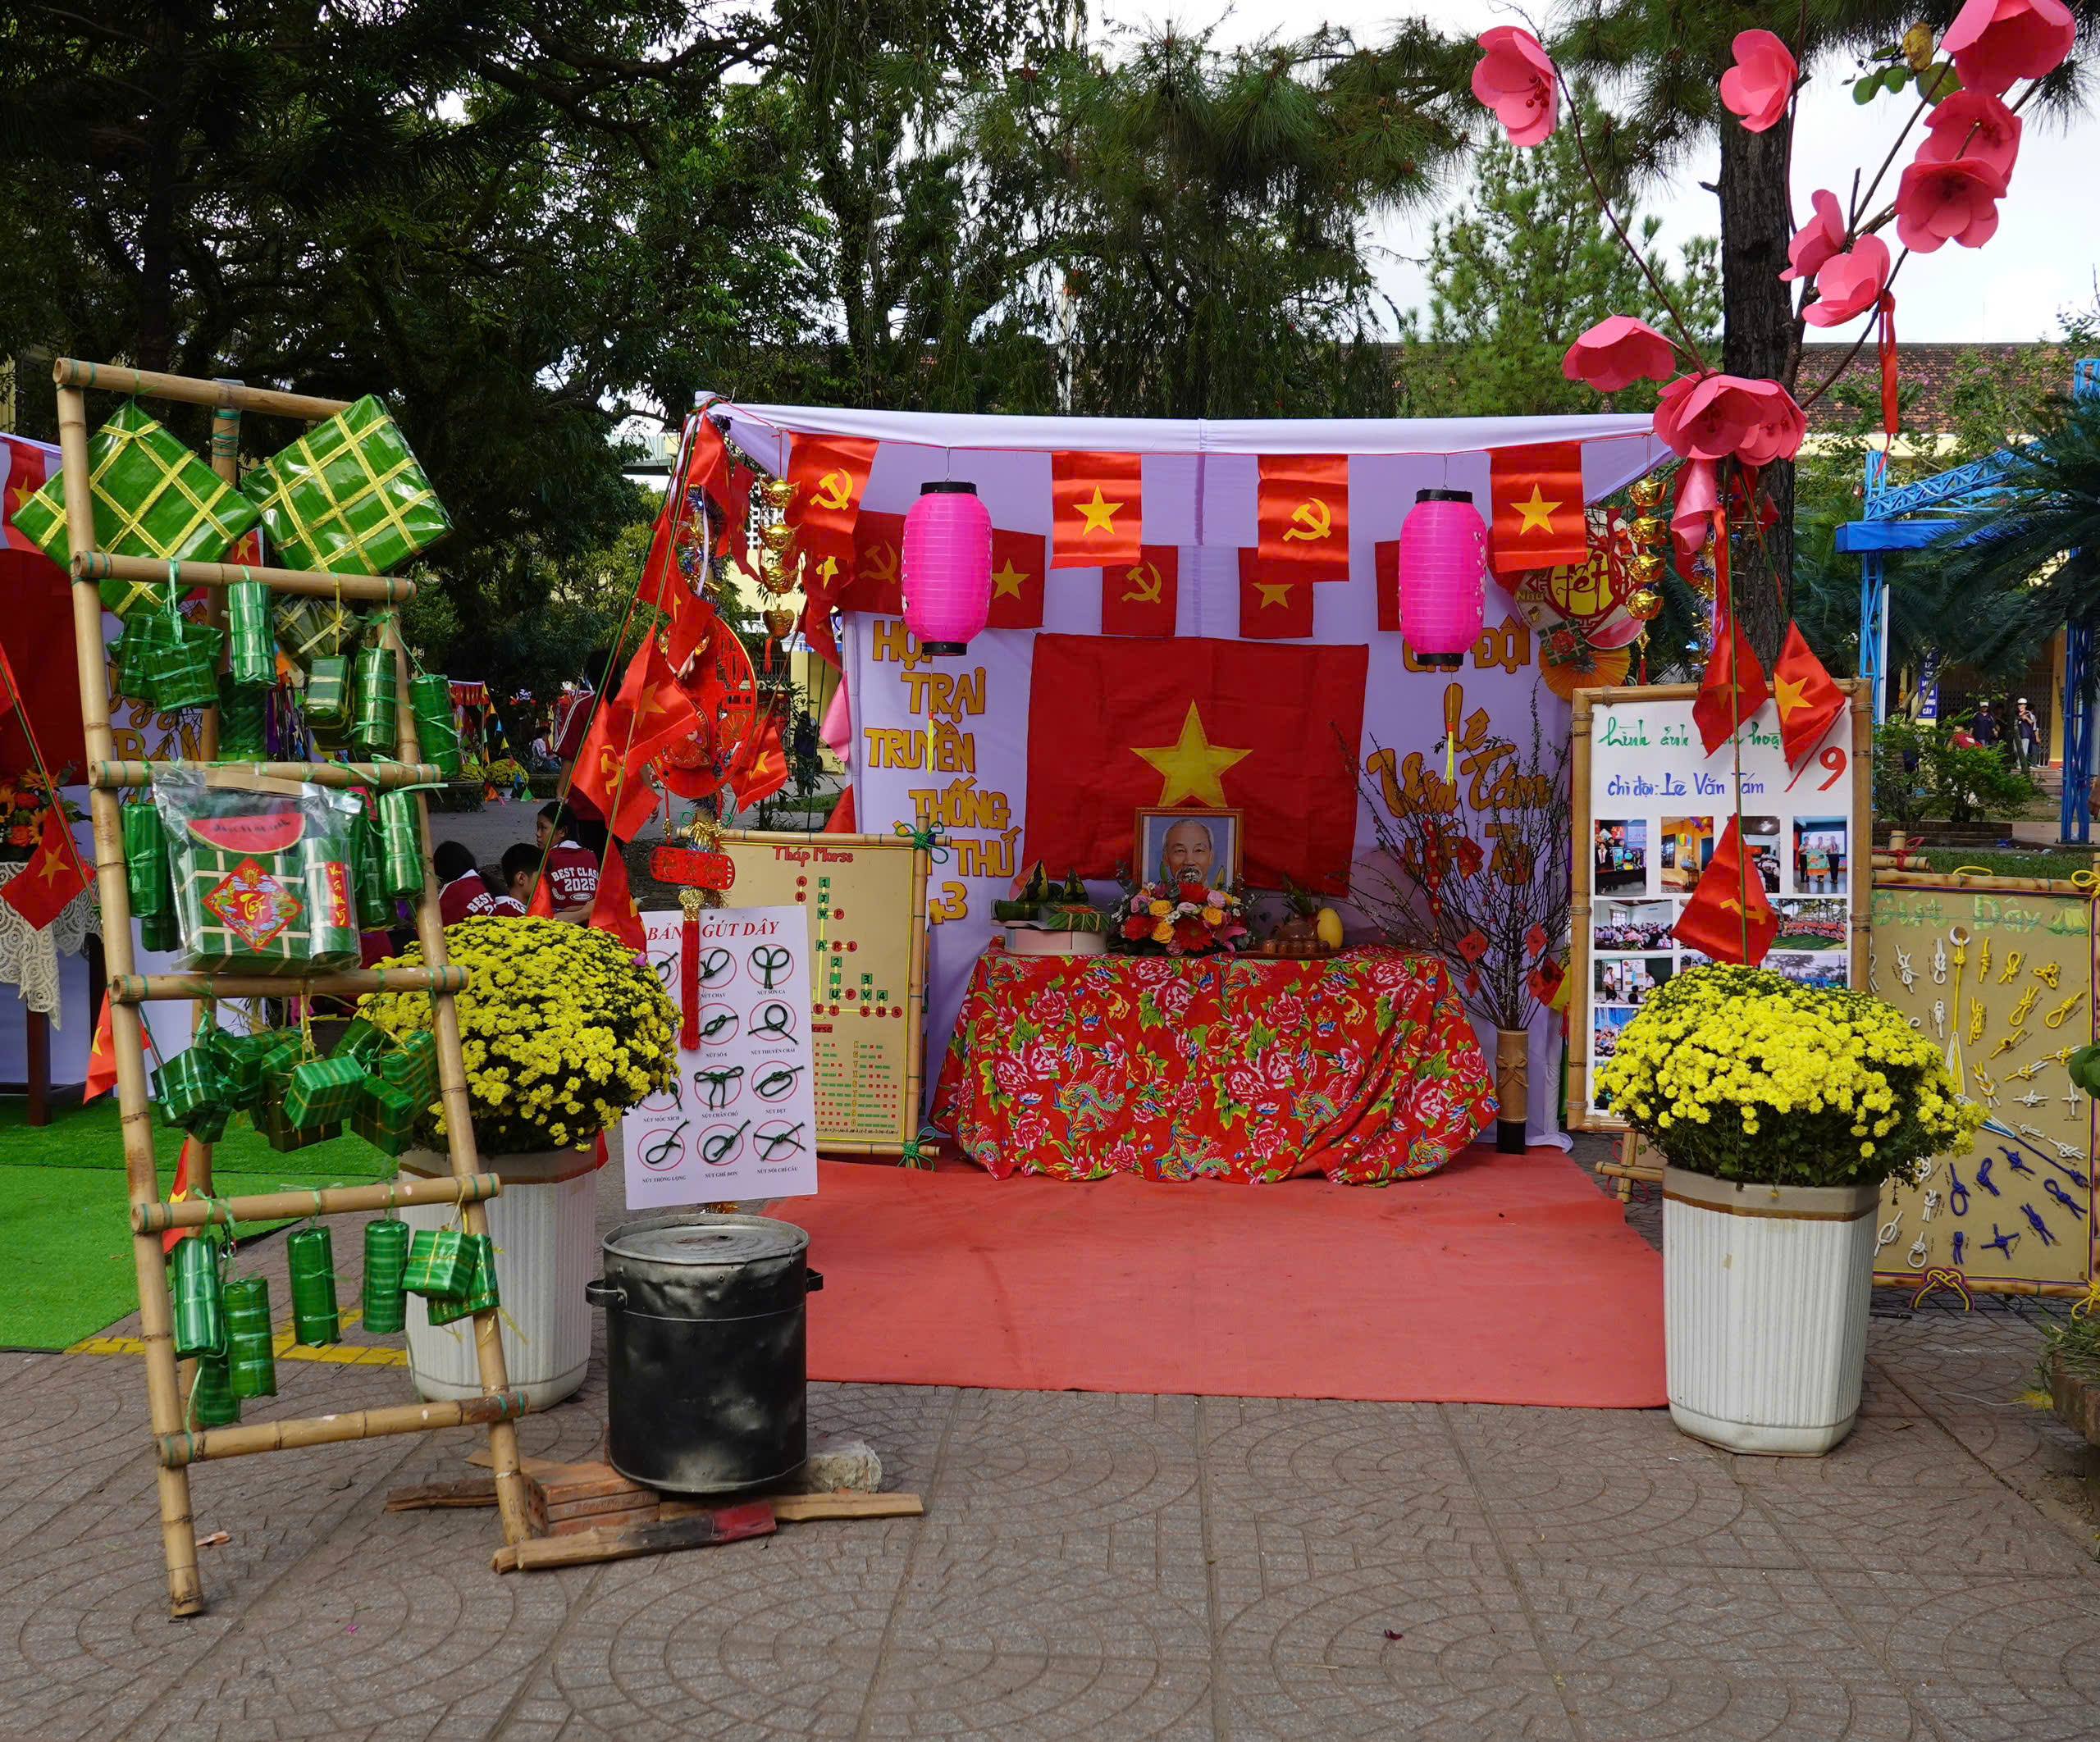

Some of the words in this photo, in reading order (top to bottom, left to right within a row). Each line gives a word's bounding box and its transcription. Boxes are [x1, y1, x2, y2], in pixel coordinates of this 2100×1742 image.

[873, 617, 933, 670] HỘ
[1470, 614, 1531, 674] ĐỘI
[901, 667, 987, 723] TRẠI
[864, 718, 976, 773] TRUYỀN
[1607, 774, 1631, 796] chi
[1660, 772, 1687, 796] Lê
[1693, 773, 1725, 796] Văn
[908, 776, 1011, 831] THỐNG
[773, 846, 810, 867] Tháp
[950, 825, 1024, 878] THỨ
[551, 868, 575, 882] BEST
[564, 878, 596, 892] 2025
[467, 892, 494, 914] BEST
[647, 922, 684, 941] BẢN
[702, 920, 739, 937] GÚT
[743, 918, 779, 936] DÂY
